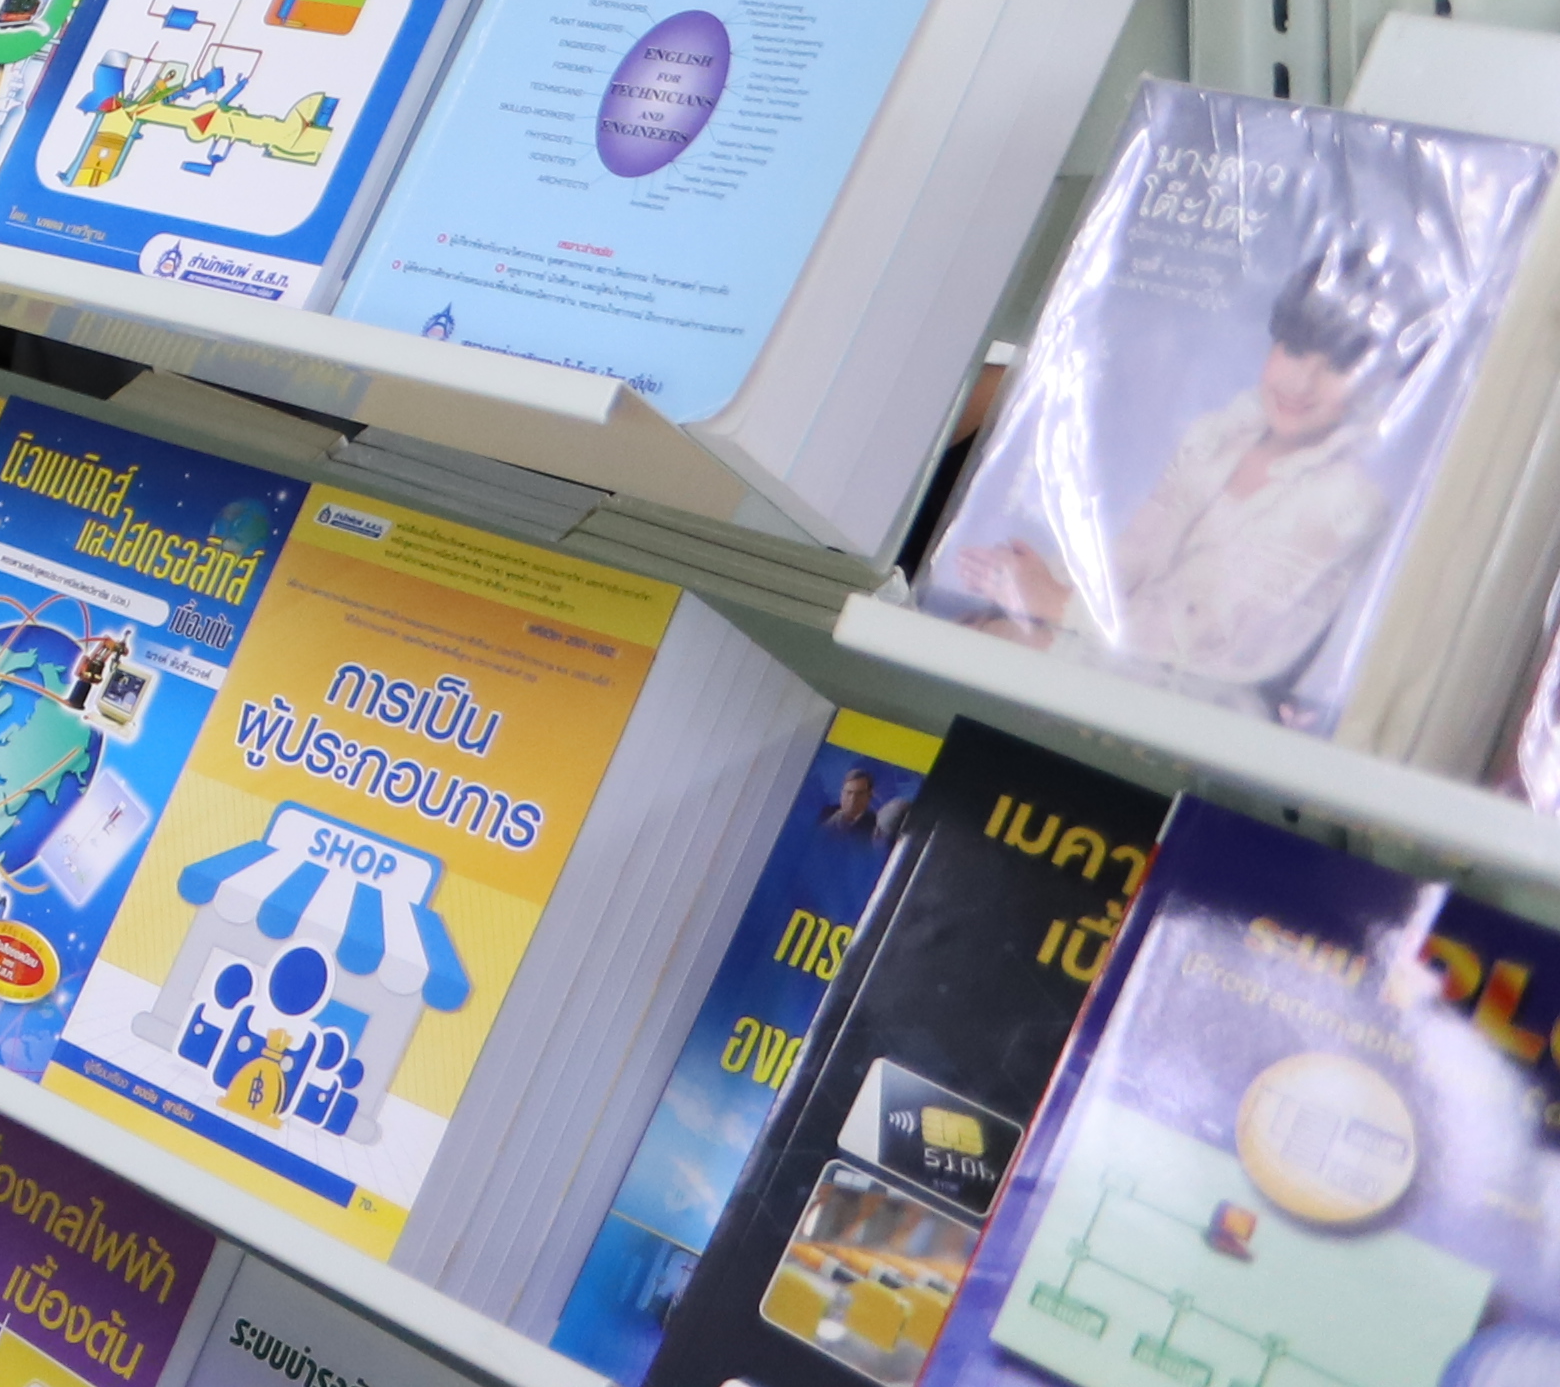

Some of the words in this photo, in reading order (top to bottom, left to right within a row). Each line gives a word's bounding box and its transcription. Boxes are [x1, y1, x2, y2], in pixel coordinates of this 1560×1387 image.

[643, 47, 713, 68] ENGLISH
[656, 72, 682, 83] FOR
[610, 83, 715, 108] TECHNICIANS
[638, 111, 664, 122] AND
[600, 120, 689, 145] ENGINEERS
[187, 252, 254, 279] สำนักพิมพ์
[252, 269, 289, 288] ส.ส.ท.
[0, 432, 140, 520] นิวแมติกส์
[75, 507, 266, 608] และไฮดรอลิกส์
[168, 598, 234, 650] เบื้องต้น
[326, 658, 503, 760] การเป็น
[235, 696, 547, 851] ผู้ประกอบการ
[308, 827, 399, 881] SHOP
[984, 794, 1150, 896] เมคา
[1036, 897, 1126, 983] เบื้
[1380, 933, 1560, 1070] PL
[357, 1195, 380, 1217] 70.-
[1, 1261, 145, 1382] เบื้องต้น
